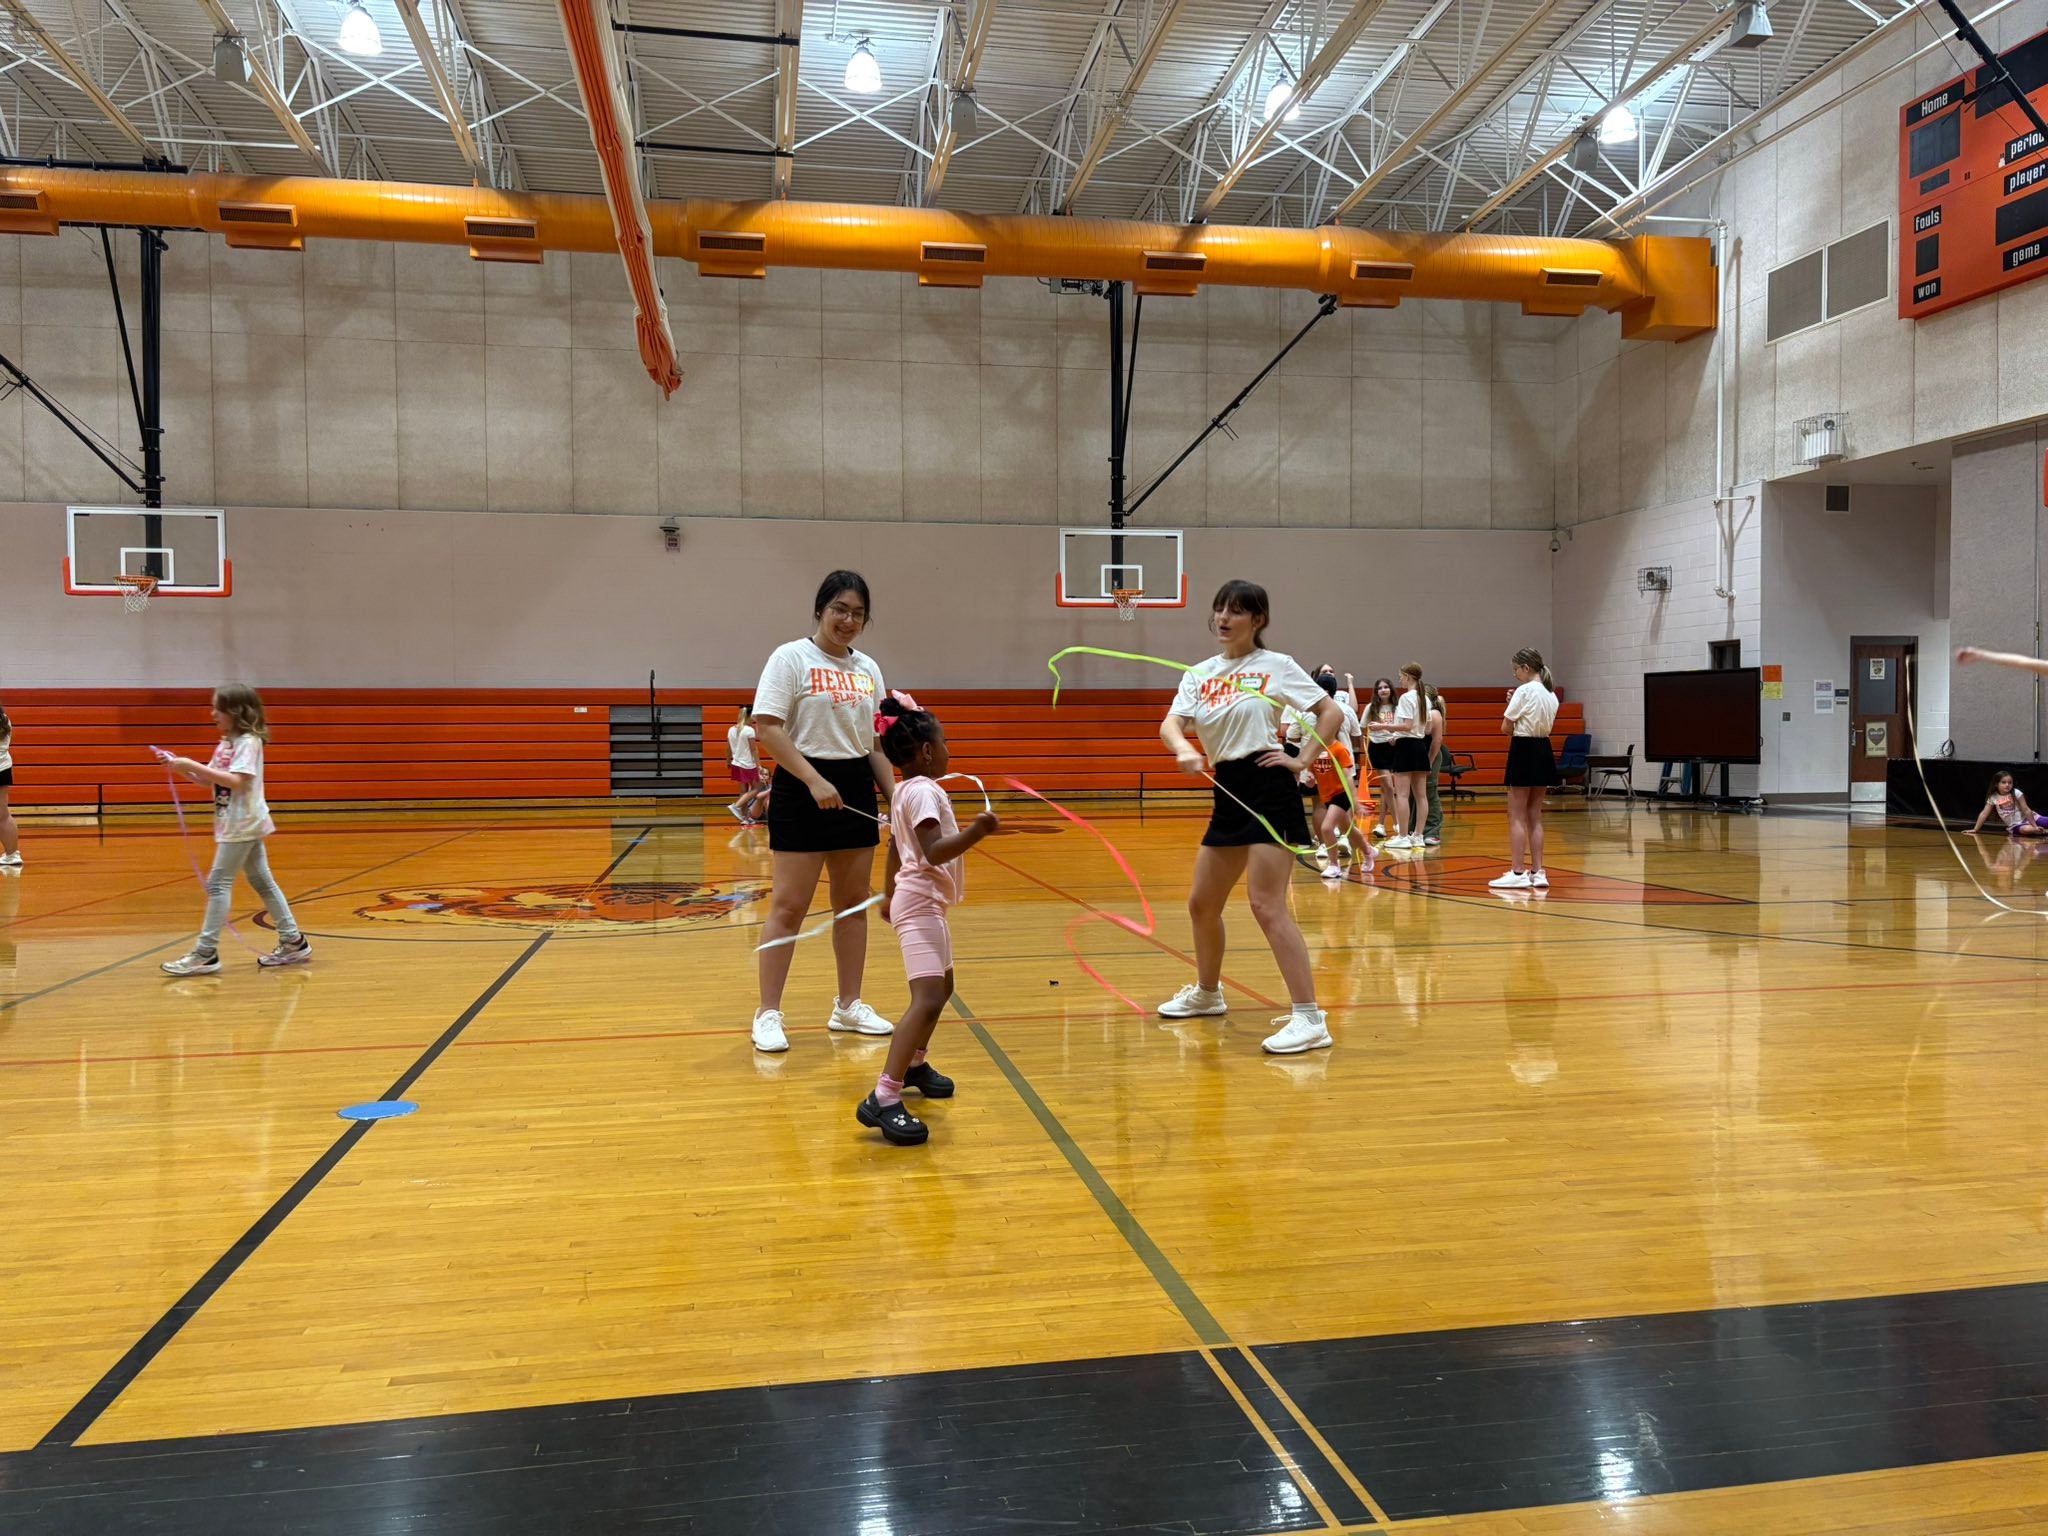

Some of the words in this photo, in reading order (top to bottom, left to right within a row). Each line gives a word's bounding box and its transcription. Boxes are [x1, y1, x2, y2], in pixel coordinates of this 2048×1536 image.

[1922, 92, 1948, 117] Home
[2010, 163, 2046, 192] player
[1915, 210, 1940, 231] fouls
[2012, 243, 2040, 266] game
[1917, 282, 1937, 298] won
